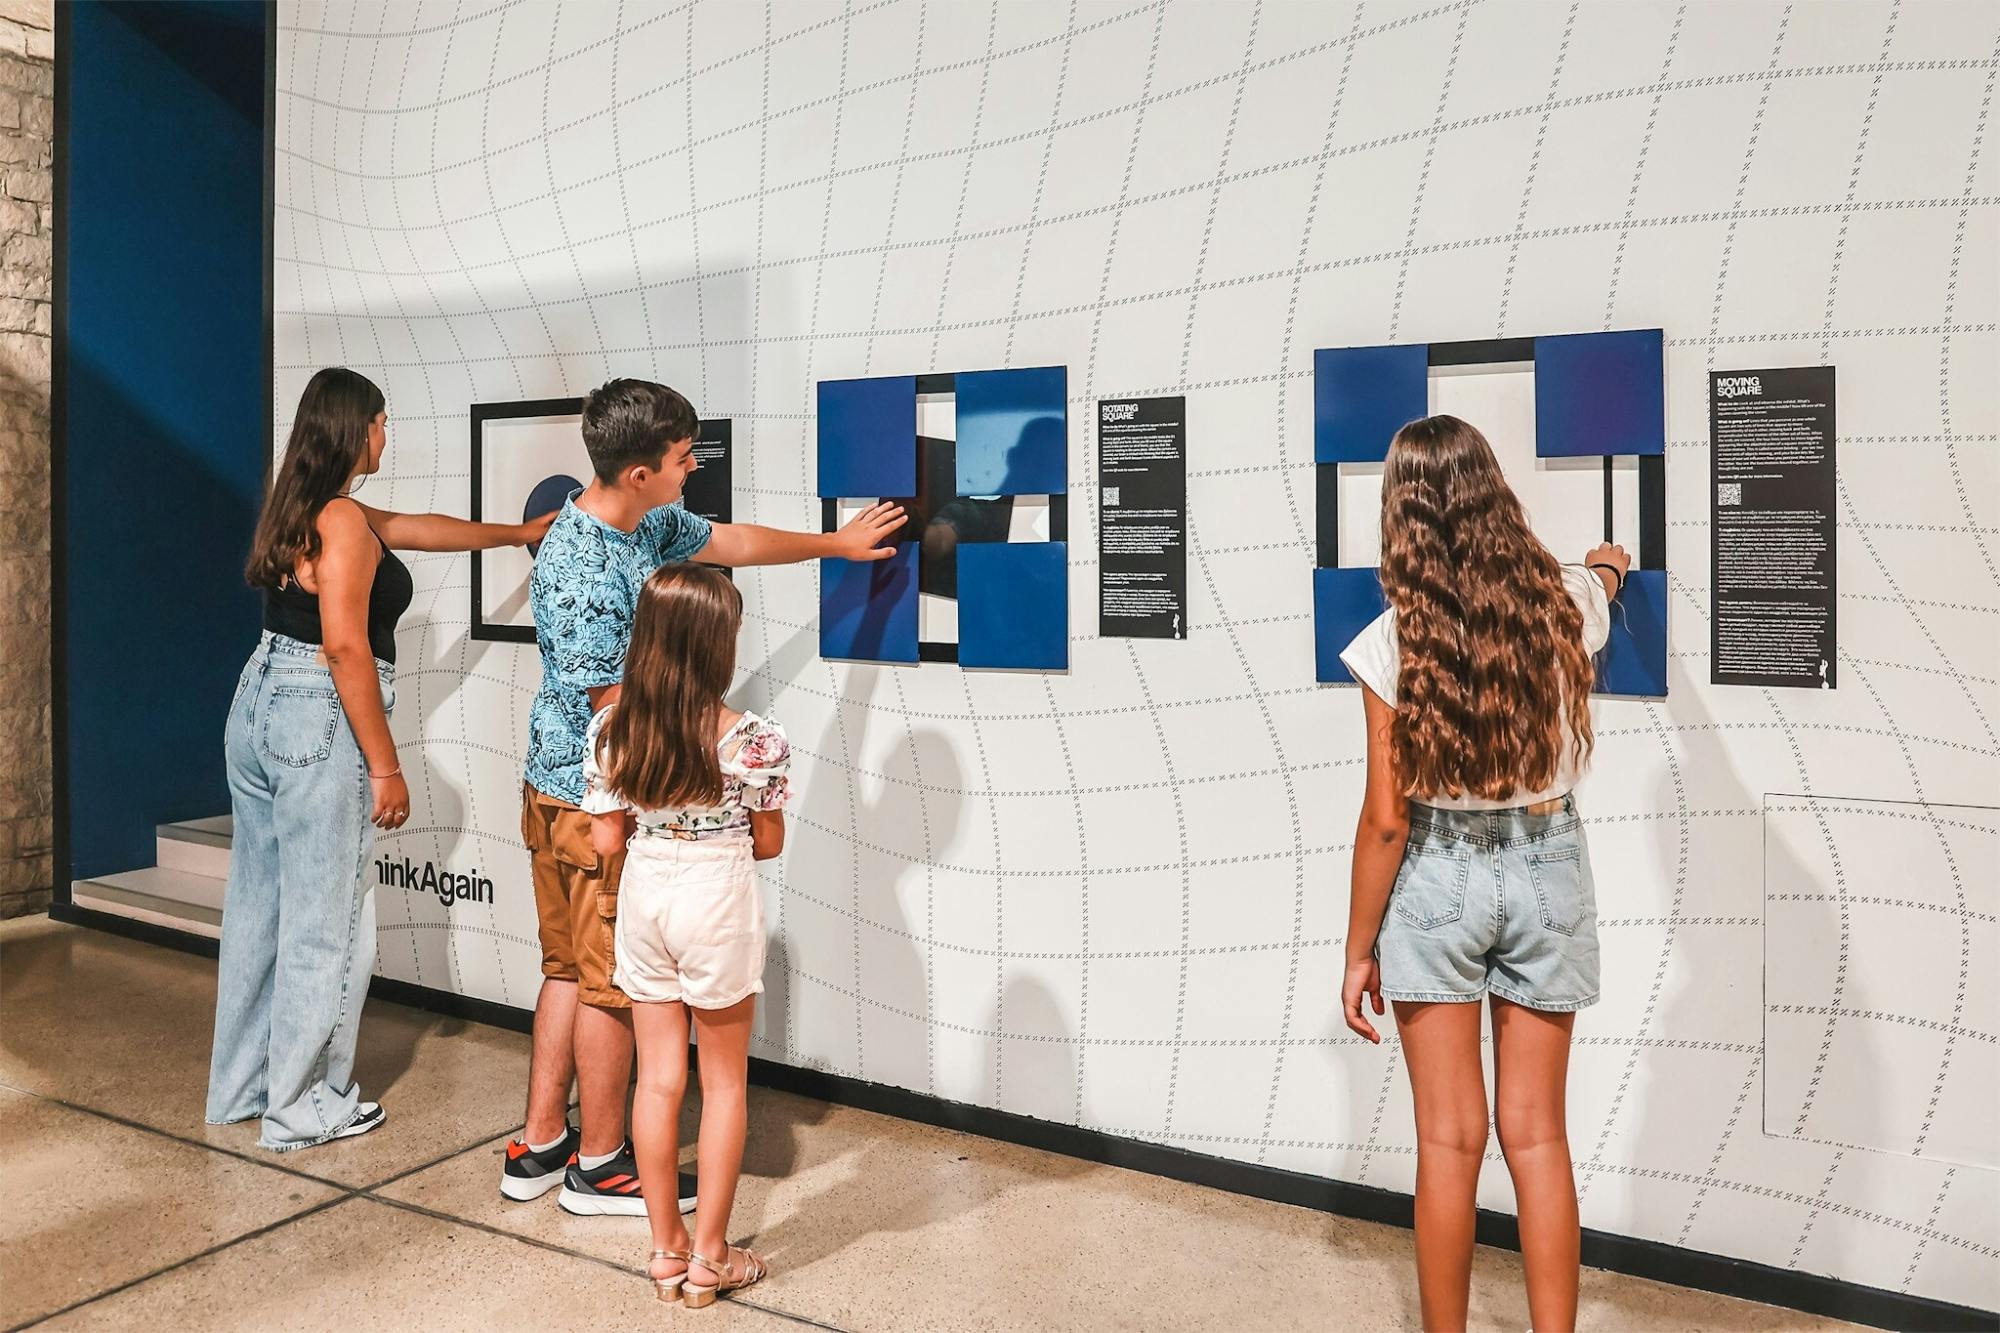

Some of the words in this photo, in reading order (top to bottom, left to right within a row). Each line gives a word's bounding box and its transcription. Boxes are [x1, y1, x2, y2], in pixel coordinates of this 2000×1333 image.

[1717, 376, 1760, 387] MOVING
[1717, 386, 1763, 398] SQUARE
[1102, 403, 1139, 413] ROTATING
[1102, 411, 1135, 422] SQUARE
